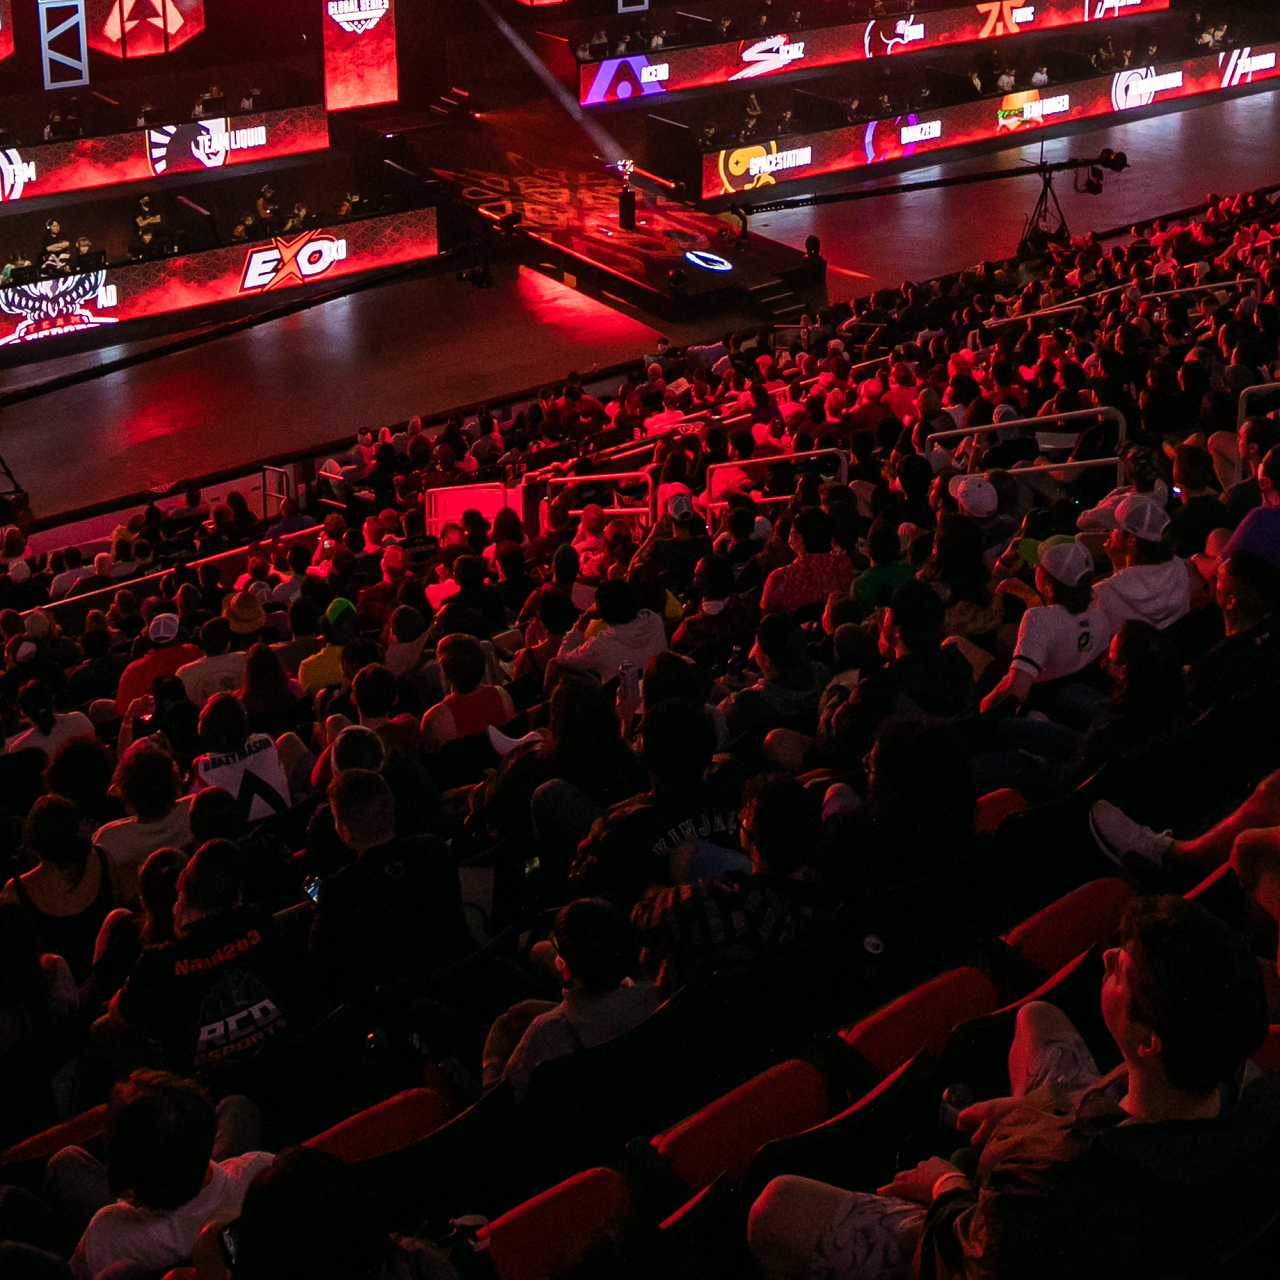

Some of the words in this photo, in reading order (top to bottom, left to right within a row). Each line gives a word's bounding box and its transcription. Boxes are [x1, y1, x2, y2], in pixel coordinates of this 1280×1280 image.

[327, 0, 360, 16] GLOBAL
[196, 132, 230, 155] TEAM
[230, 124, 266, 151] LIQUID
[7, 160, 36, 185] TSM
[749, 146, 811, 175] SPACESTATION
[244, 229, 337, 292] EXO
[323, 239, 347, 264] EXO
[96, 284, 118, 309] AD
